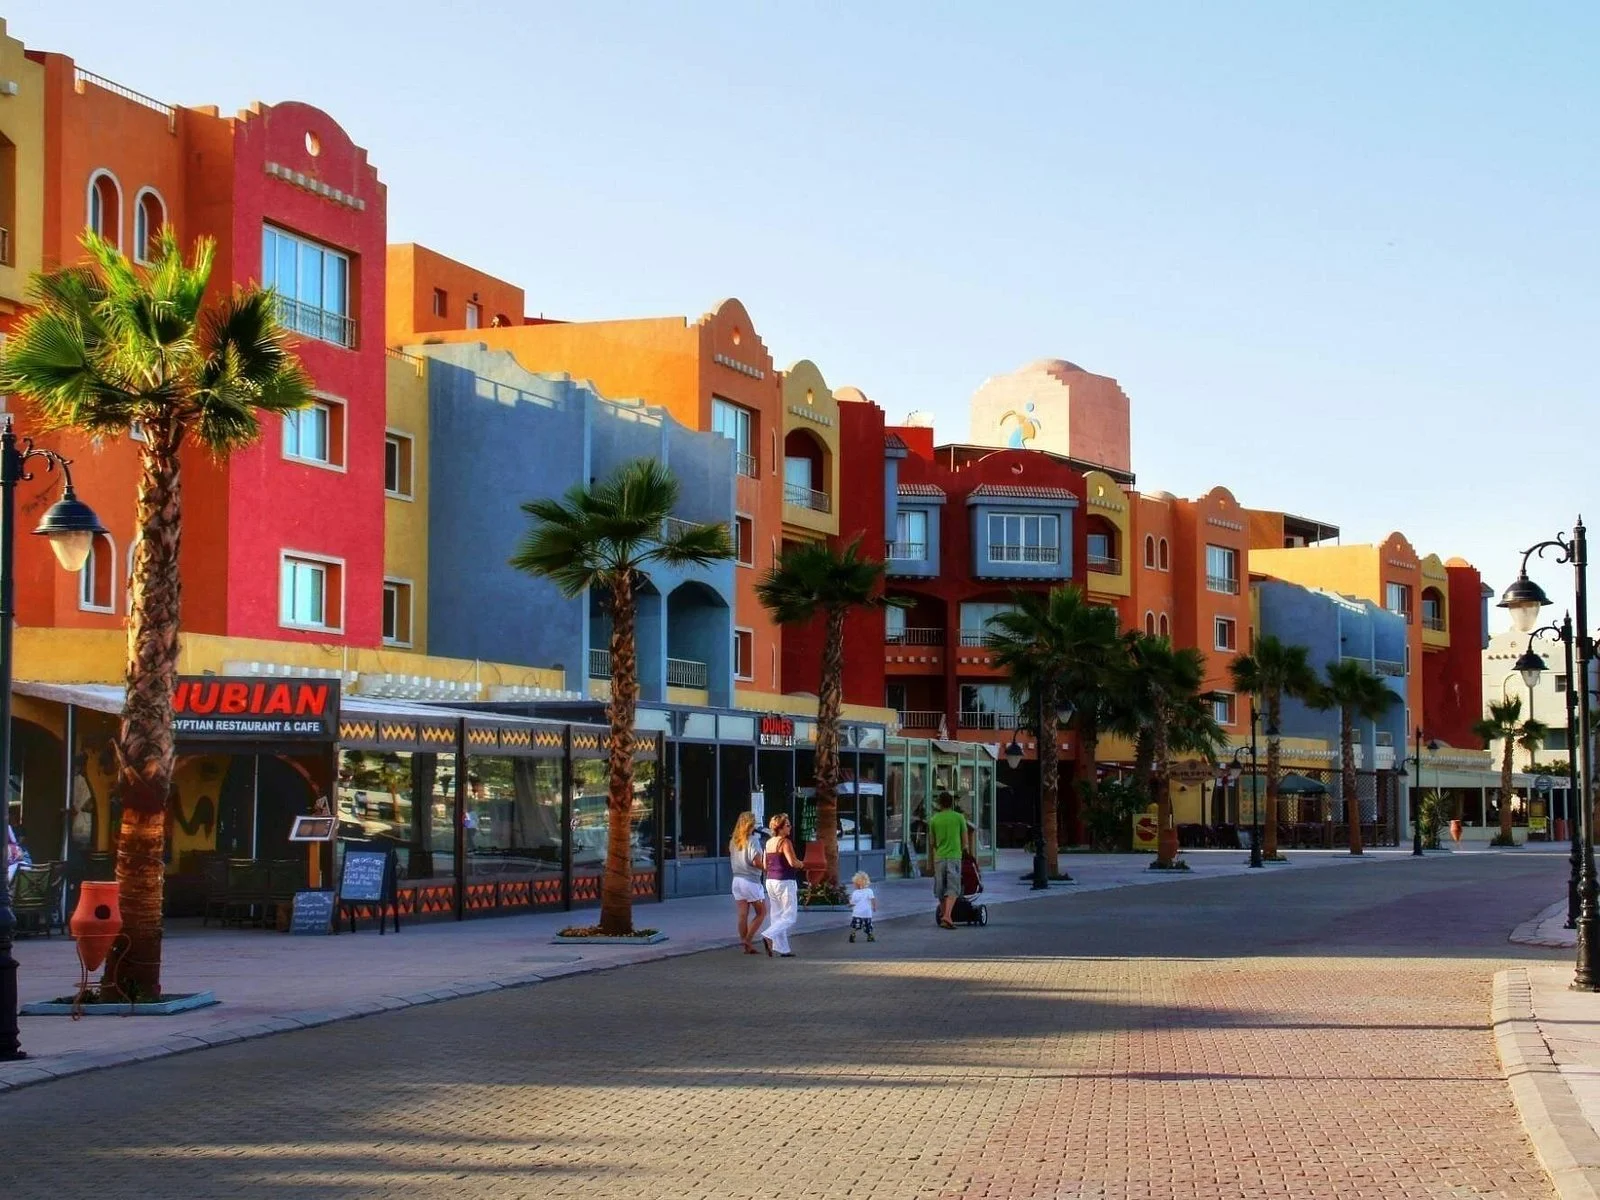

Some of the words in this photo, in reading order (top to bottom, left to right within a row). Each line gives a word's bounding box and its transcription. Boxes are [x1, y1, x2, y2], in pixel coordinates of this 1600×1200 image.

[171, 720, 214, 731] GYPTIAN
[215, 720, 281, 732] RESTAURANT
[283, 721, 291, 732] &
[294, 722, 320, 732] CAFE
